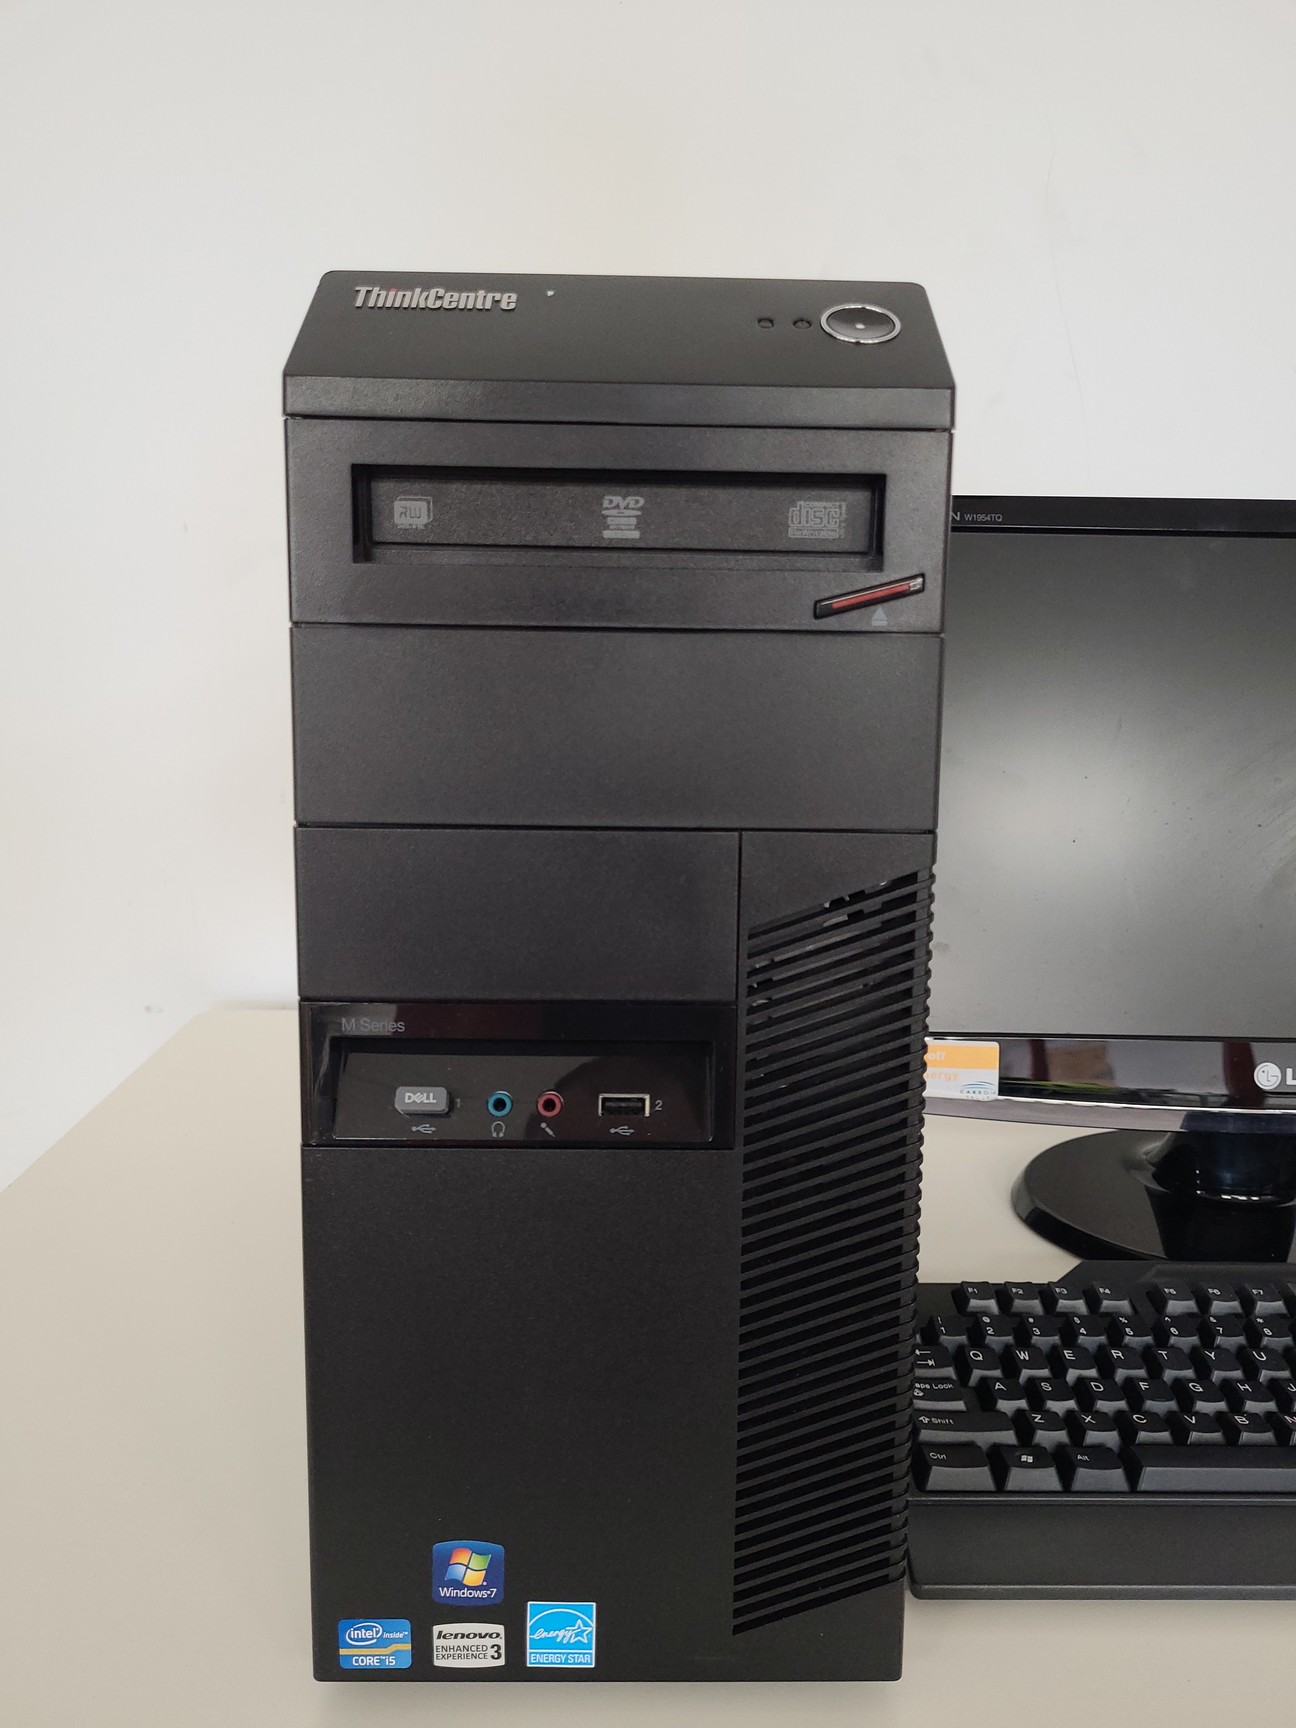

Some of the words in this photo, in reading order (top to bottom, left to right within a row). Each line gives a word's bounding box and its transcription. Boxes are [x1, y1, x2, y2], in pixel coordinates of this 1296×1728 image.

[355, 286, 518, 310] ThinkCentre
[603, 496, 644, 510] DVD
[341, 1018, 356, 1031] M
[360, 1018, 406, 1032] Series
[404, 1092, 437, 1104] DELL
[655, 1099, 663, 1110] 2
[986, 1327, 995, 1335] 2
[1032, 1327, 1041, 1335] 3
[1125, 1327, 1134, 1336] 5
[969, 1350, 984, 1361] Q
[1016, 1350, 1030, 1361] W
[1063, 1350, 1076, 1360] E
[1111, 1350, 1125, 1360] R
[1158, 1350, 1168, 1360] T
[1204, 1350, 1216, 1360] Y
[1252, 1350, 1267, 1361] U
[994, 1382, 1007, 1391] A
[1040, 1382, 1052, 1391] S
[1090, 1382, 1104, 1391] D
[1138, 1382, 1149, 1391] F
[1188, 1382, 1204, 1392] G
[1237, 1383, 1252, 1392] H
[931, 1417, 954, 1425] Shift
[1031, 1414, 1045, 1423] Z
[1081, 1414, 1096, 1424] X
[1132, 1414, 1147, 1424] C
[1184, 1414, 1196, 1424] V
[1234, 1415, 1249, 1425] B
[929, 1452, 947, 1460] Ctrl
[350, 1627, 377, 1639] intel
[436, 1630, 500, 1640] lenovo
[490, 1644, 502, 1660] 3
[385, 1656, 396, 1666] i5
[530, 1654, 567, 1663] ENERGY
[567, 1654, 591, 1663] STAR
